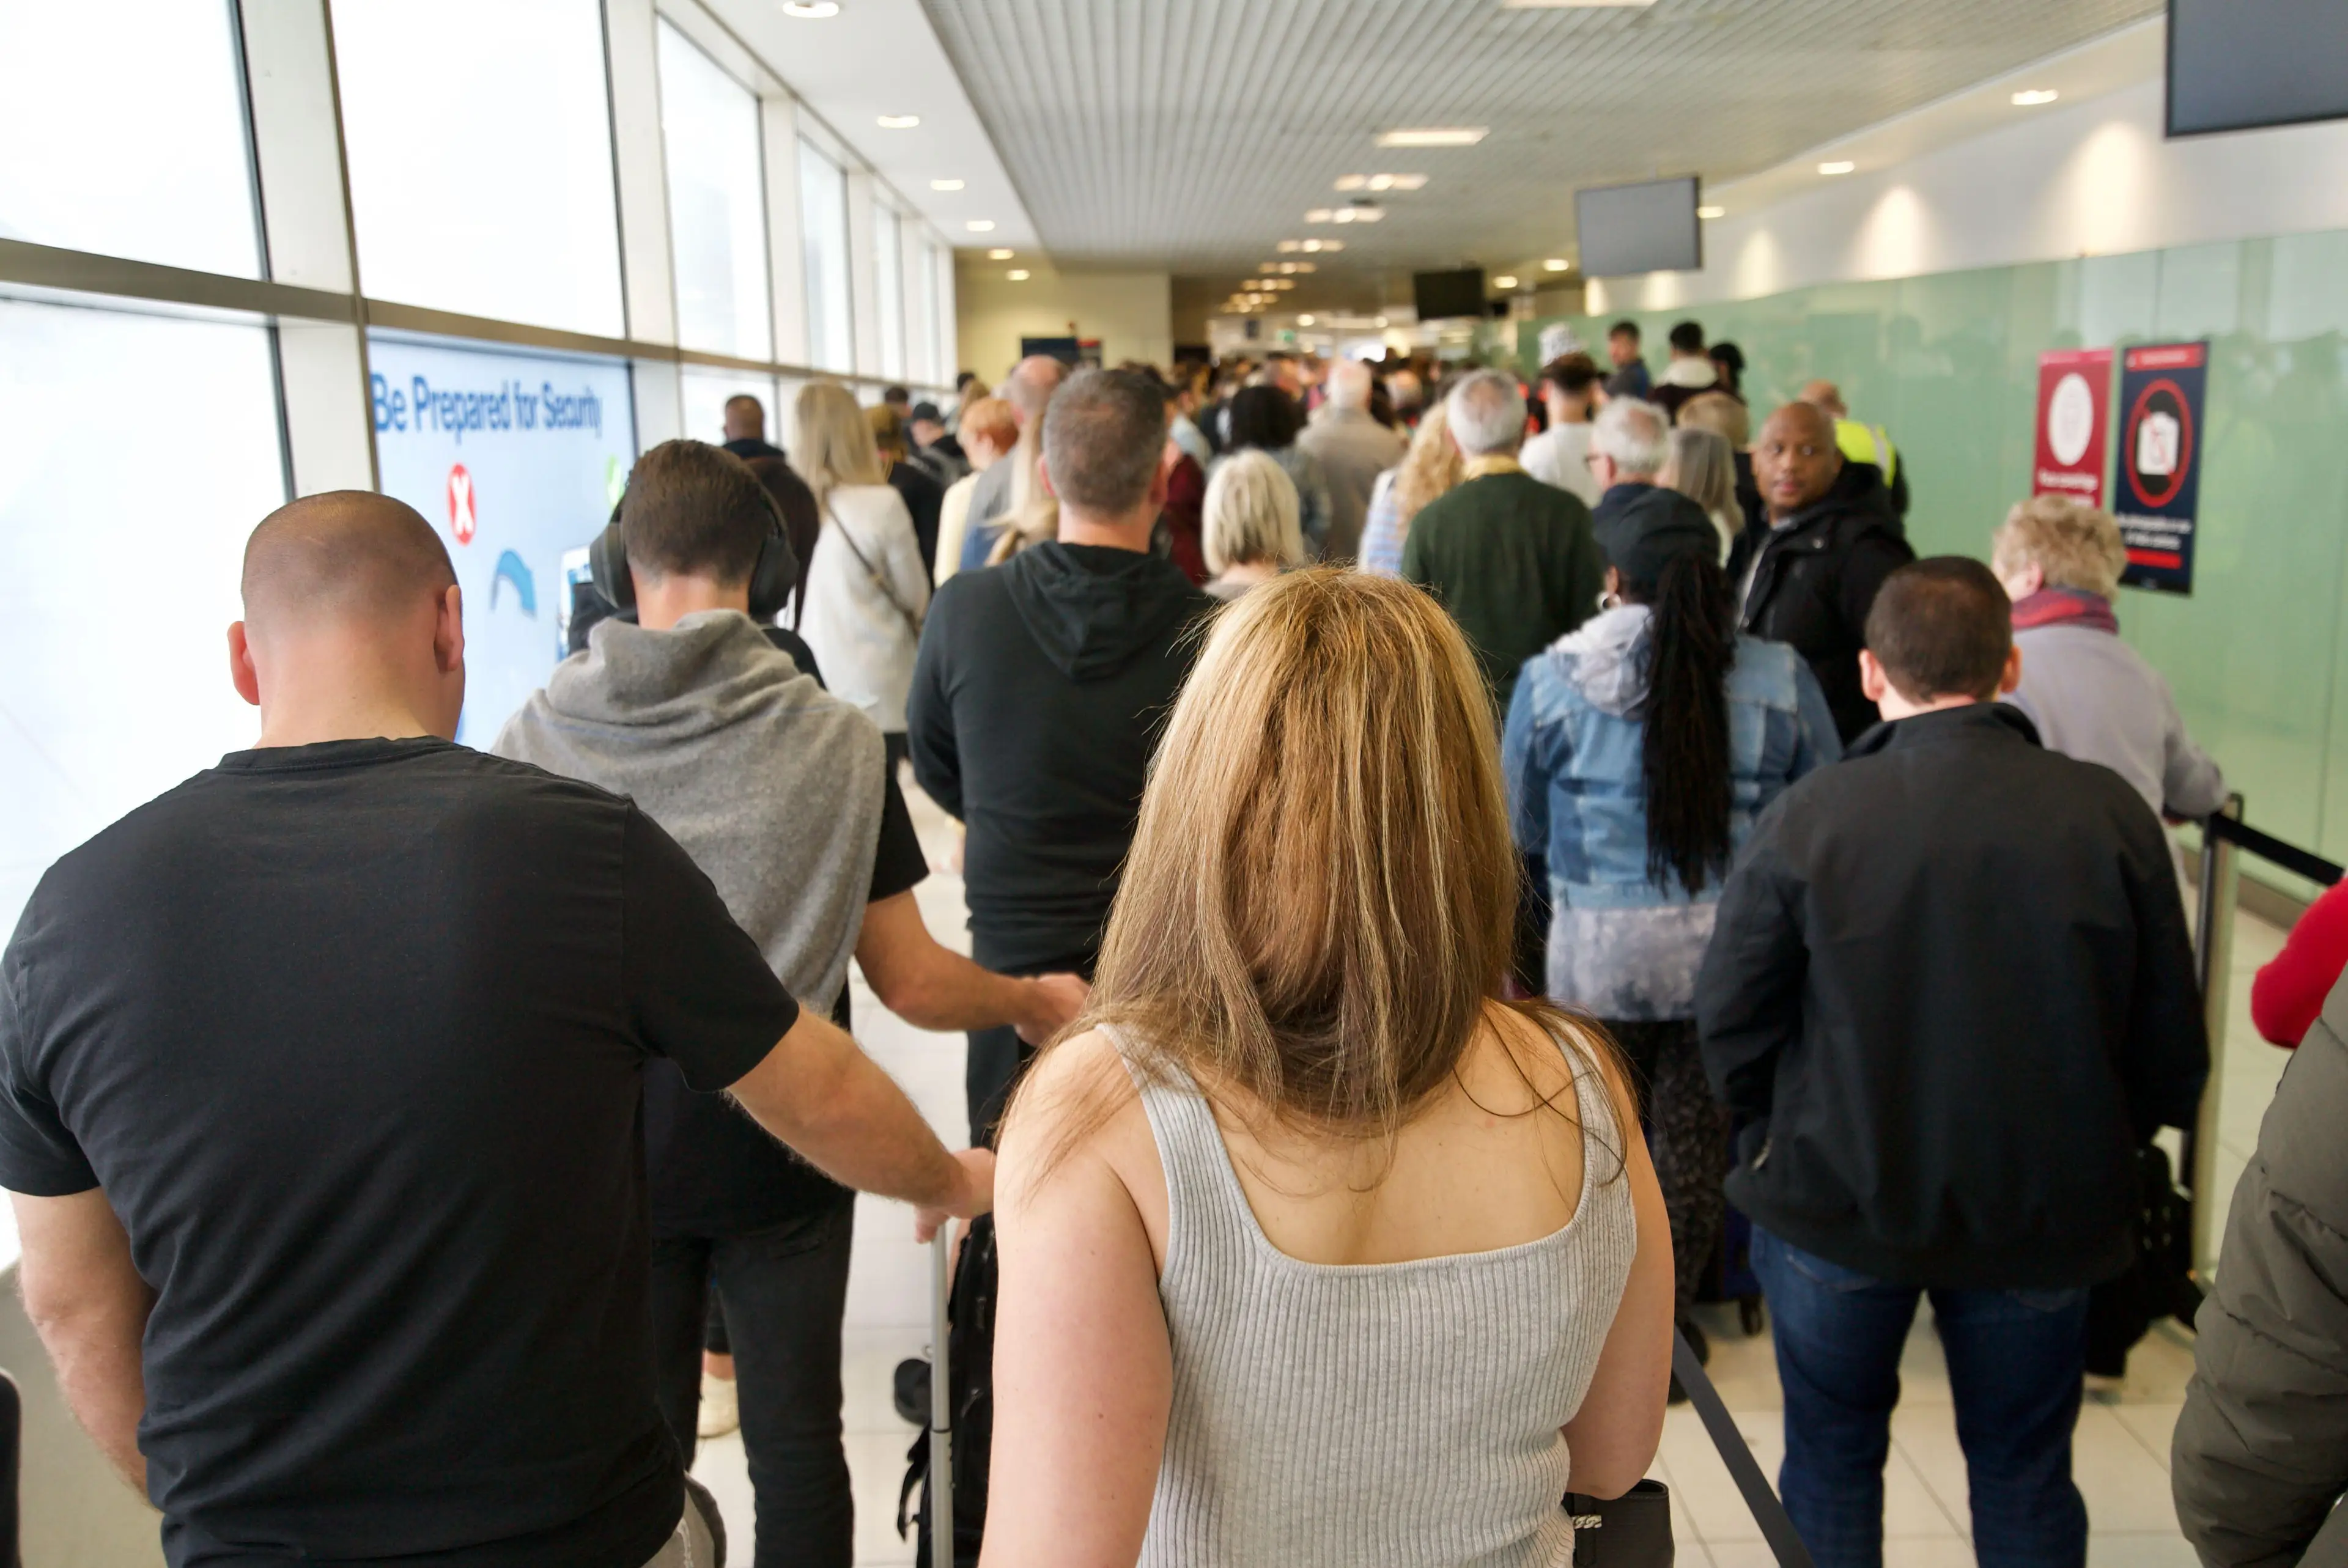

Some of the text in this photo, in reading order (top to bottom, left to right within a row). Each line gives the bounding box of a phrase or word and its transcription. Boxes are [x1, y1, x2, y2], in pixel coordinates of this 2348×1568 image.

[371, 374, 603, 446] Be Prepared for Security
